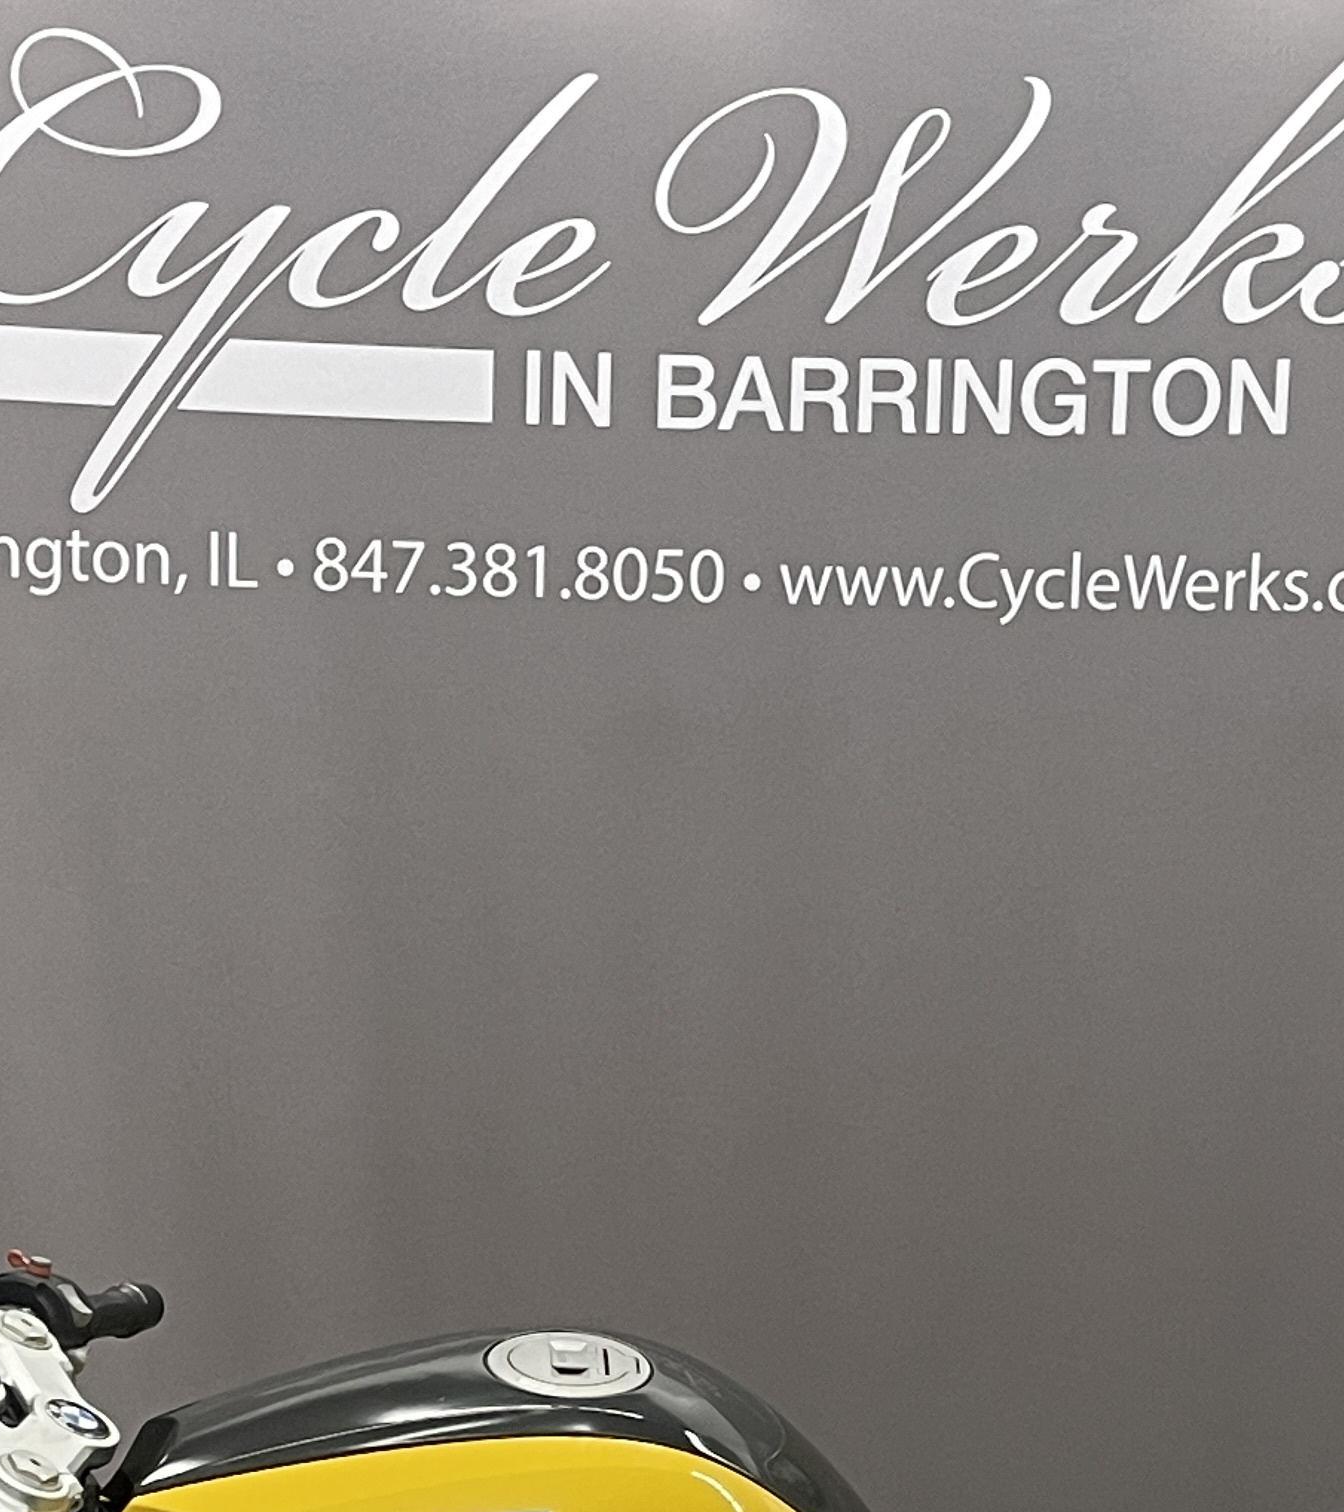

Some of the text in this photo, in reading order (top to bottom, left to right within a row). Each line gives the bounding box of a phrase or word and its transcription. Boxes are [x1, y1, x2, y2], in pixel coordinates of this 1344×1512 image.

[525, 349, 1291, 437] IN BARRINGTON
[210, 531, 259, 588] IL
[312, 536, 724, 604] 847.381.8050
